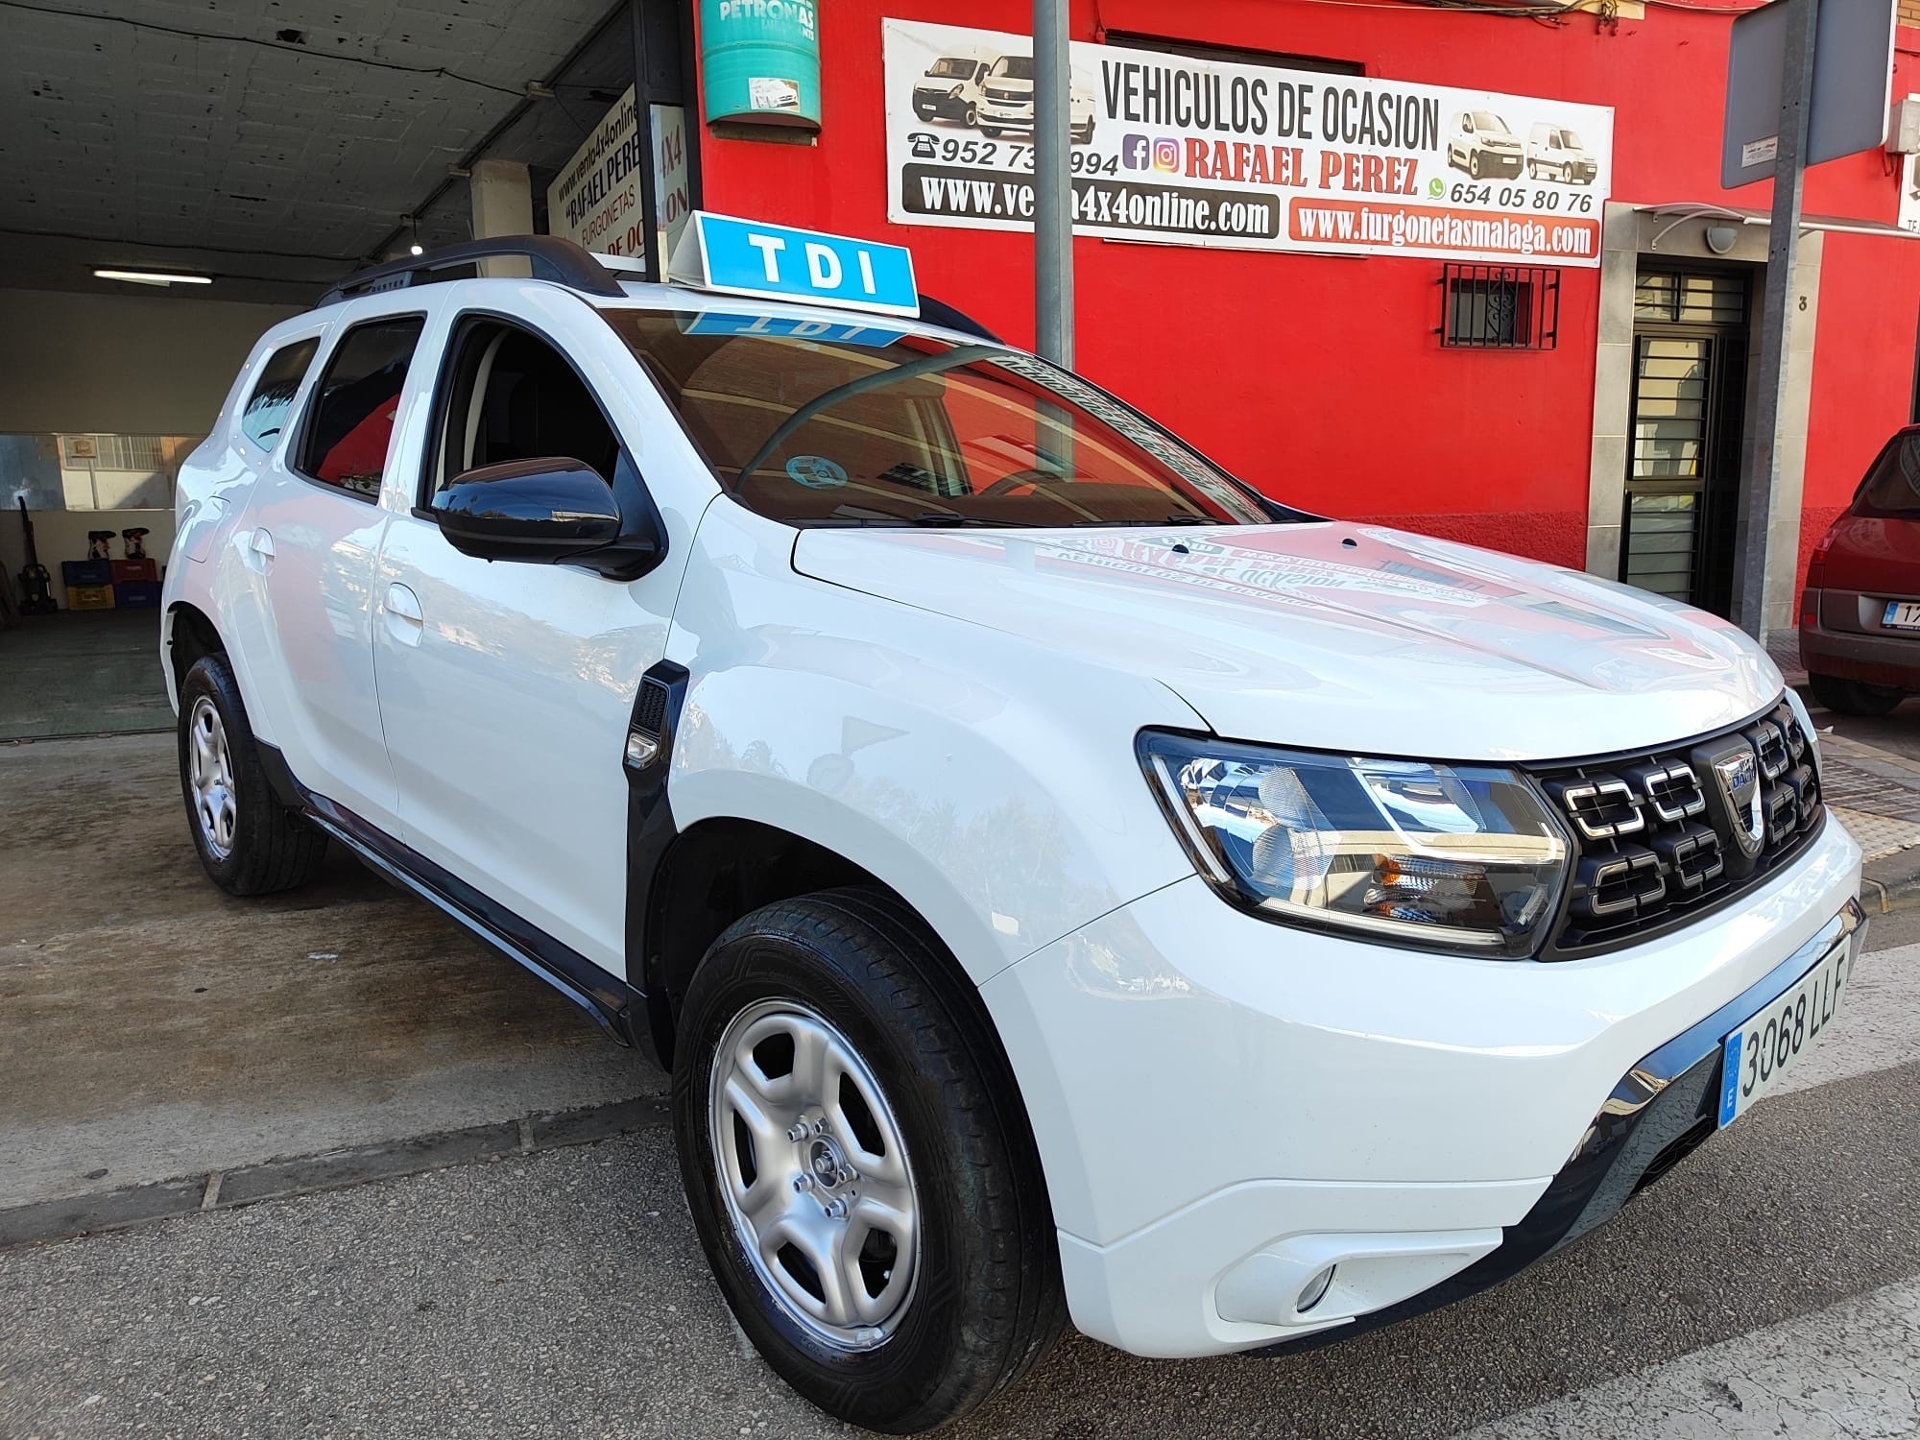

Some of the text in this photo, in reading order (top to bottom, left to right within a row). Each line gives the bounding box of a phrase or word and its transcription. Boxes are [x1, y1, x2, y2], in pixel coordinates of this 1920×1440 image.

[1102, 60, 1439, 151] VEHICULOS DE OCASION
[606, 130, 640, 191] PERE
[941, 138, 998, 166] 952
[1008, 144, 1036, 170] 73
[1185, 138, 1419, 196] RAFAEL PEREZ
[920, 176, 1269, 234] www.ve4x4online.com
[1450, 183, 1593, 213] 654 05 80 76
[1298, 206, 1591, 255] www.furgonetasmalaga.com
[1742, 993, 1807, 1098] 3068
[1809, 952, 1846, 1040] LLF
